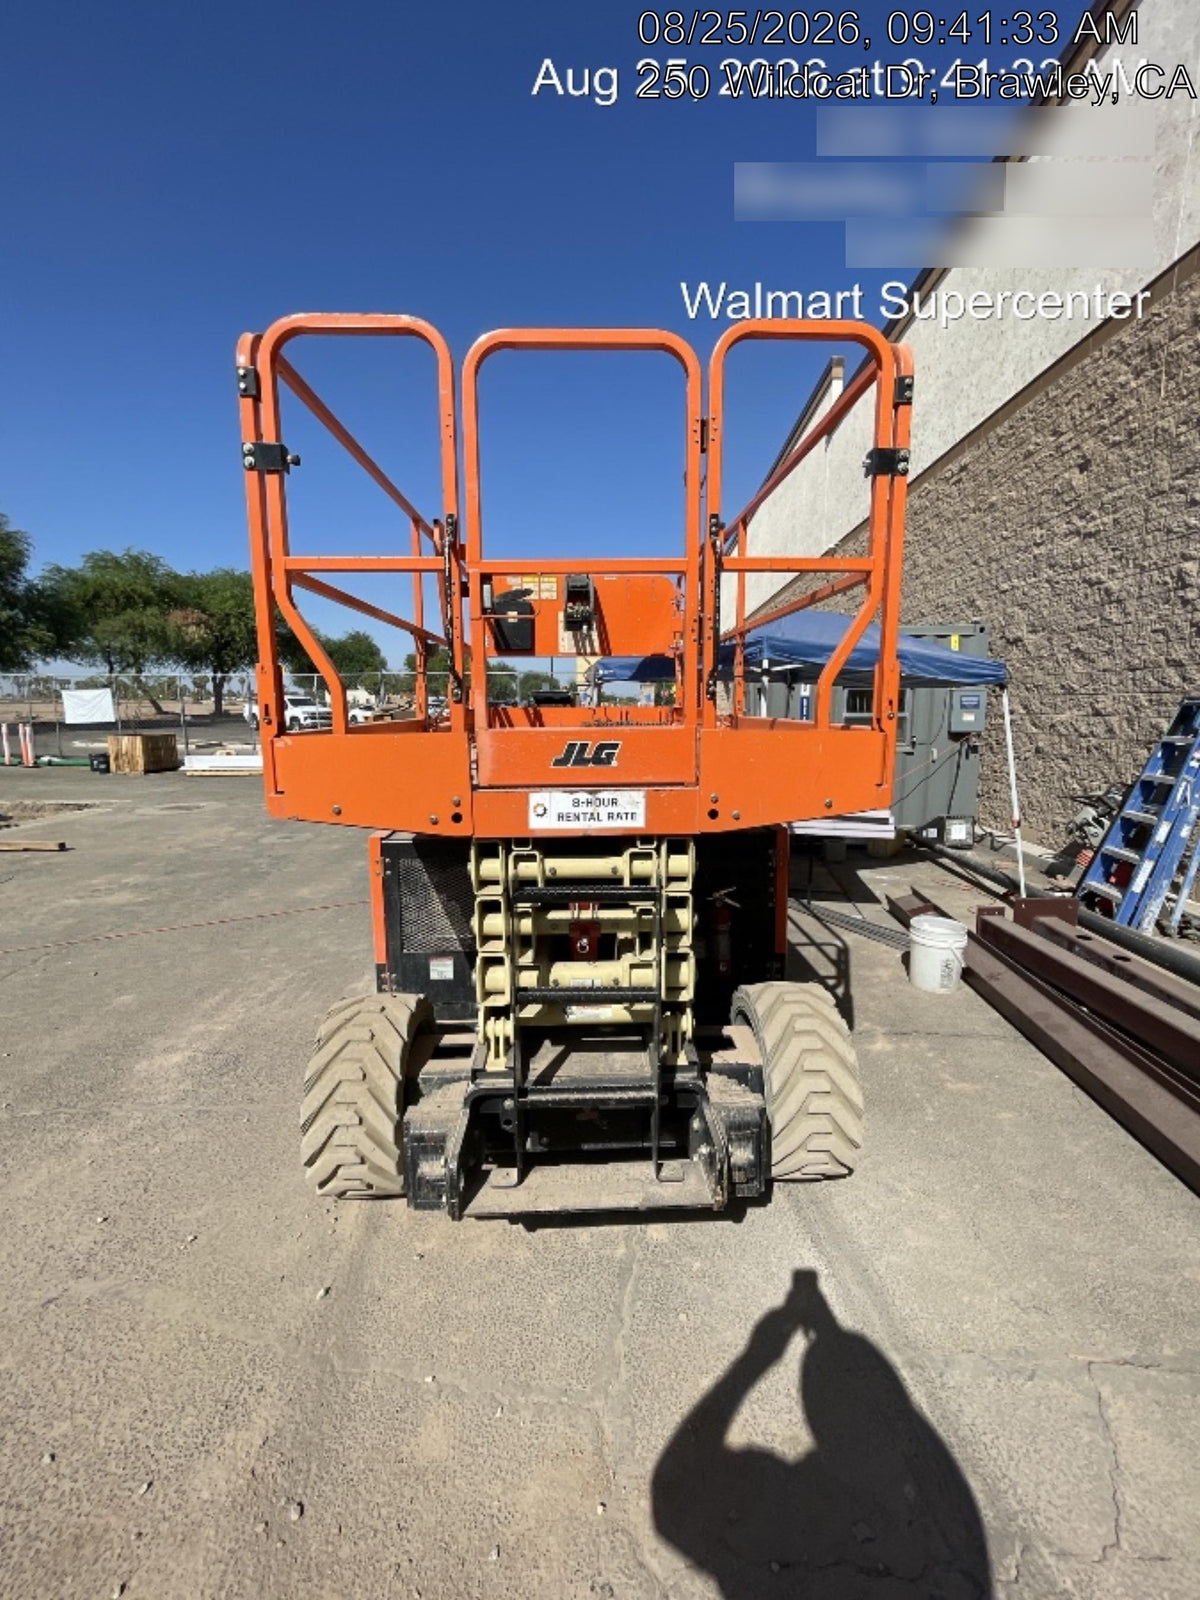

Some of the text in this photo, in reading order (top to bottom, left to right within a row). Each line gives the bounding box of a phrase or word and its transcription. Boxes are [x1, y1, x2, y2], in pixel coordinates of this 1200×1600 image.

[551, 741, 622, 768] JLG
[572, 797, 618, 808] 8-HOUR
[557, 812, 637, 823] RENTAL RATE
